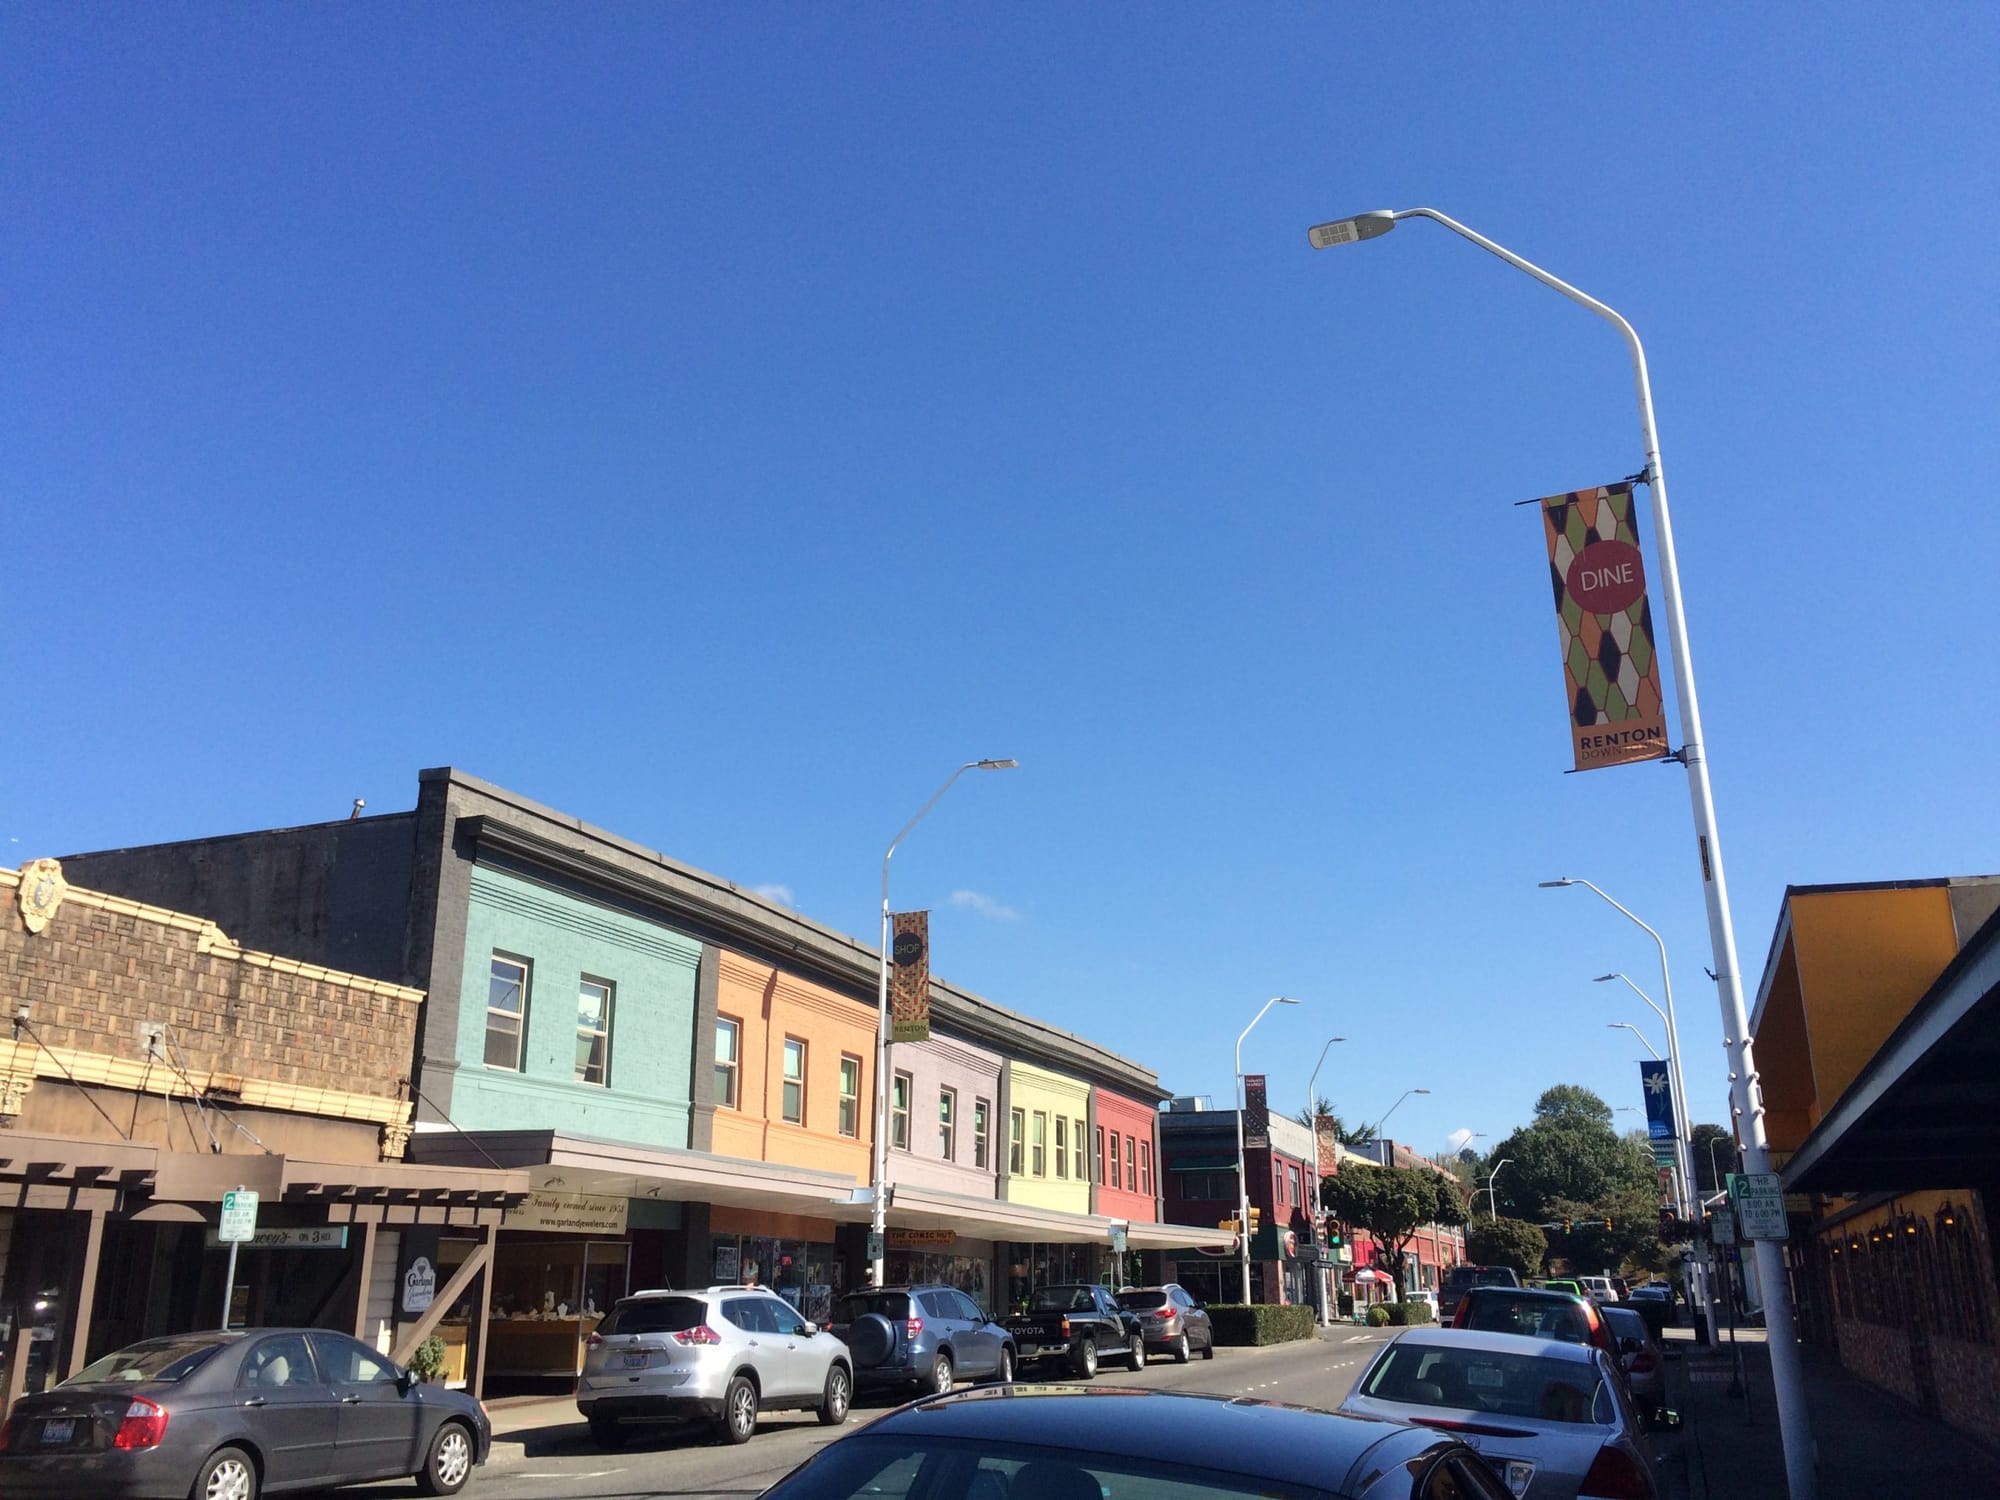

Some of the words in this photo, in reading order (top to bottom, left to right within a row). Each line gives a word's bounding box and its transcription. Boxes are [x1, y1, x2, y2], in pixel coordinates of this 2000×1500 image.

[1581, 563, 1634, 591] DINE
[1581, 726, 1661, 749] RENTON
[895, 943, 920, 955] SHOP
[894, 1024, 927, 1033] RENTON
[1757, 1176, 1769, 1185] HR
[1738, 1181, 1749, 1196] 2
[225, 1195, 234, 1209] 2
[531, 1196, 560, 1212] Family
[563, 1200, 588, 1211] owned
[1765, 1200, 1775, 1208] AM
[1744, 1210, 1753, 1218] TO
[1771, 1209, 1780, 1217] PM
[540, 1218, 618, 1230] www.garlandjewelers.com
[892, 1231, 906, 1239] THE
[909, 1231, 934, 1239] COMIC
[936, 1231, 952, 1239] HUT
[408, 1273, 433, 1287] Garland
[1009, 1327, 1045, 1335] TOYOTA
